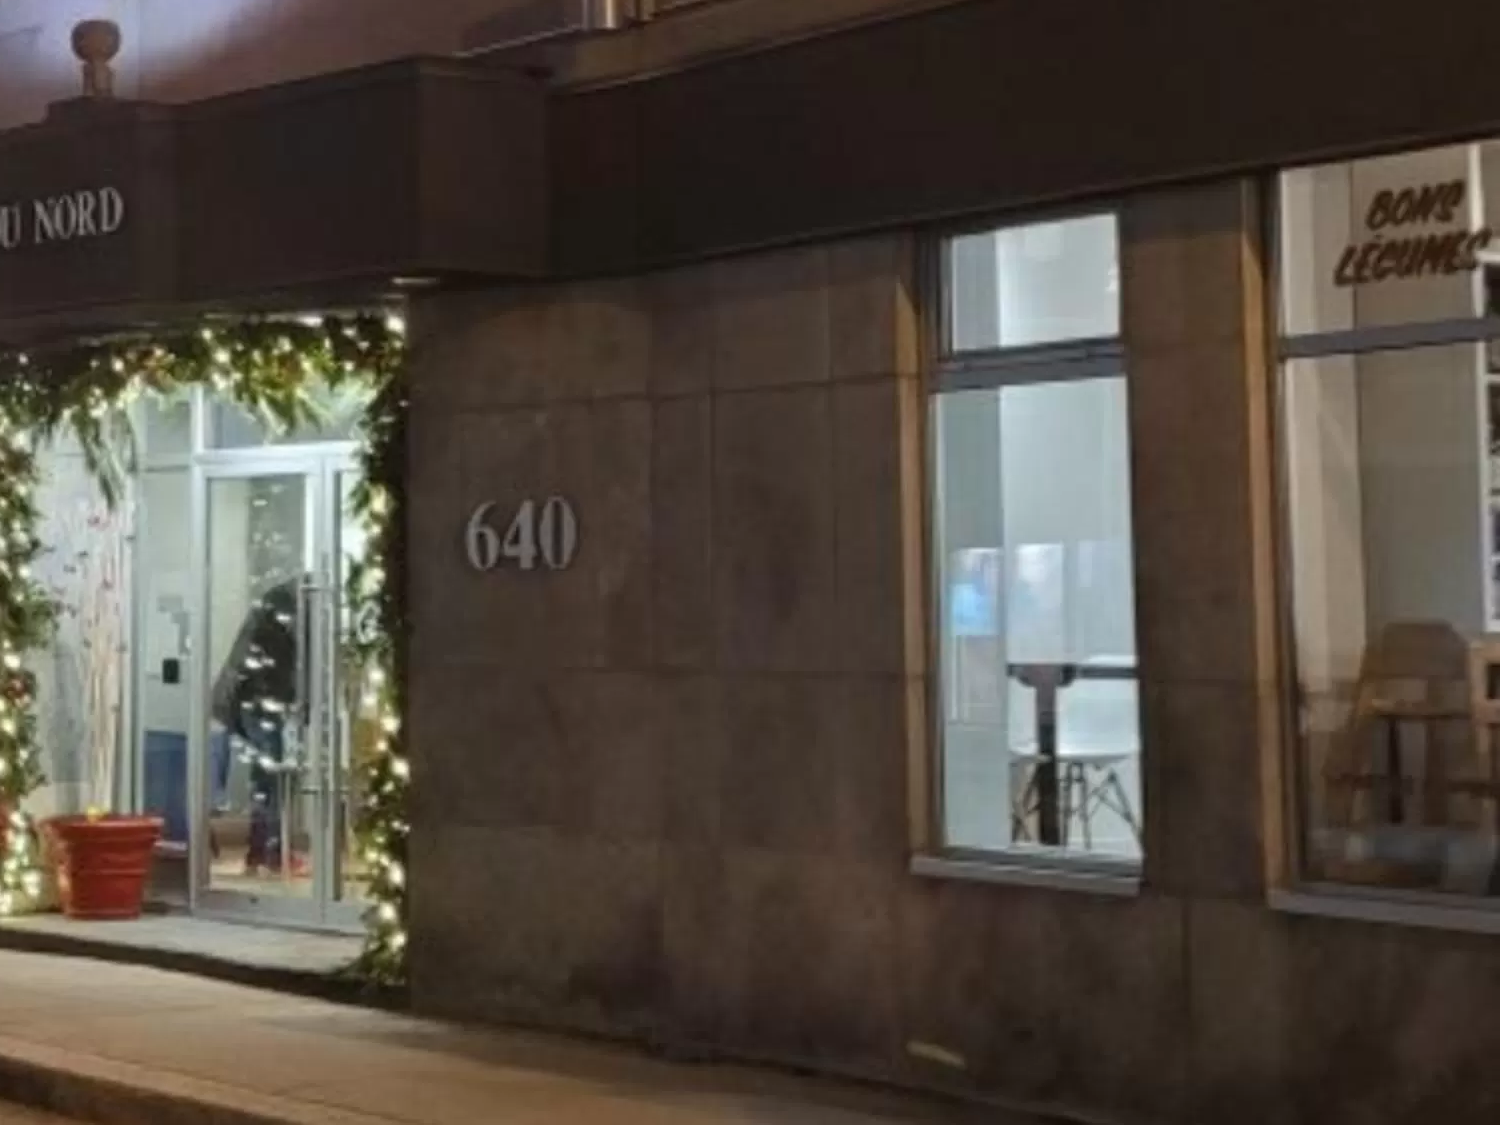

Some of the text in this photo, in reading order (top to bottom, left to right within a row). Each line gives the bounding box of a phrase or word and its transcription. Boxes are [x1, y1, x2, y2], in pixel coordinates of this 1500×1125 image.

[34, 186, 124, 243] NORD
[1365, 178, 1465, 230] BONS
[466, 496, 577, 571] 640
